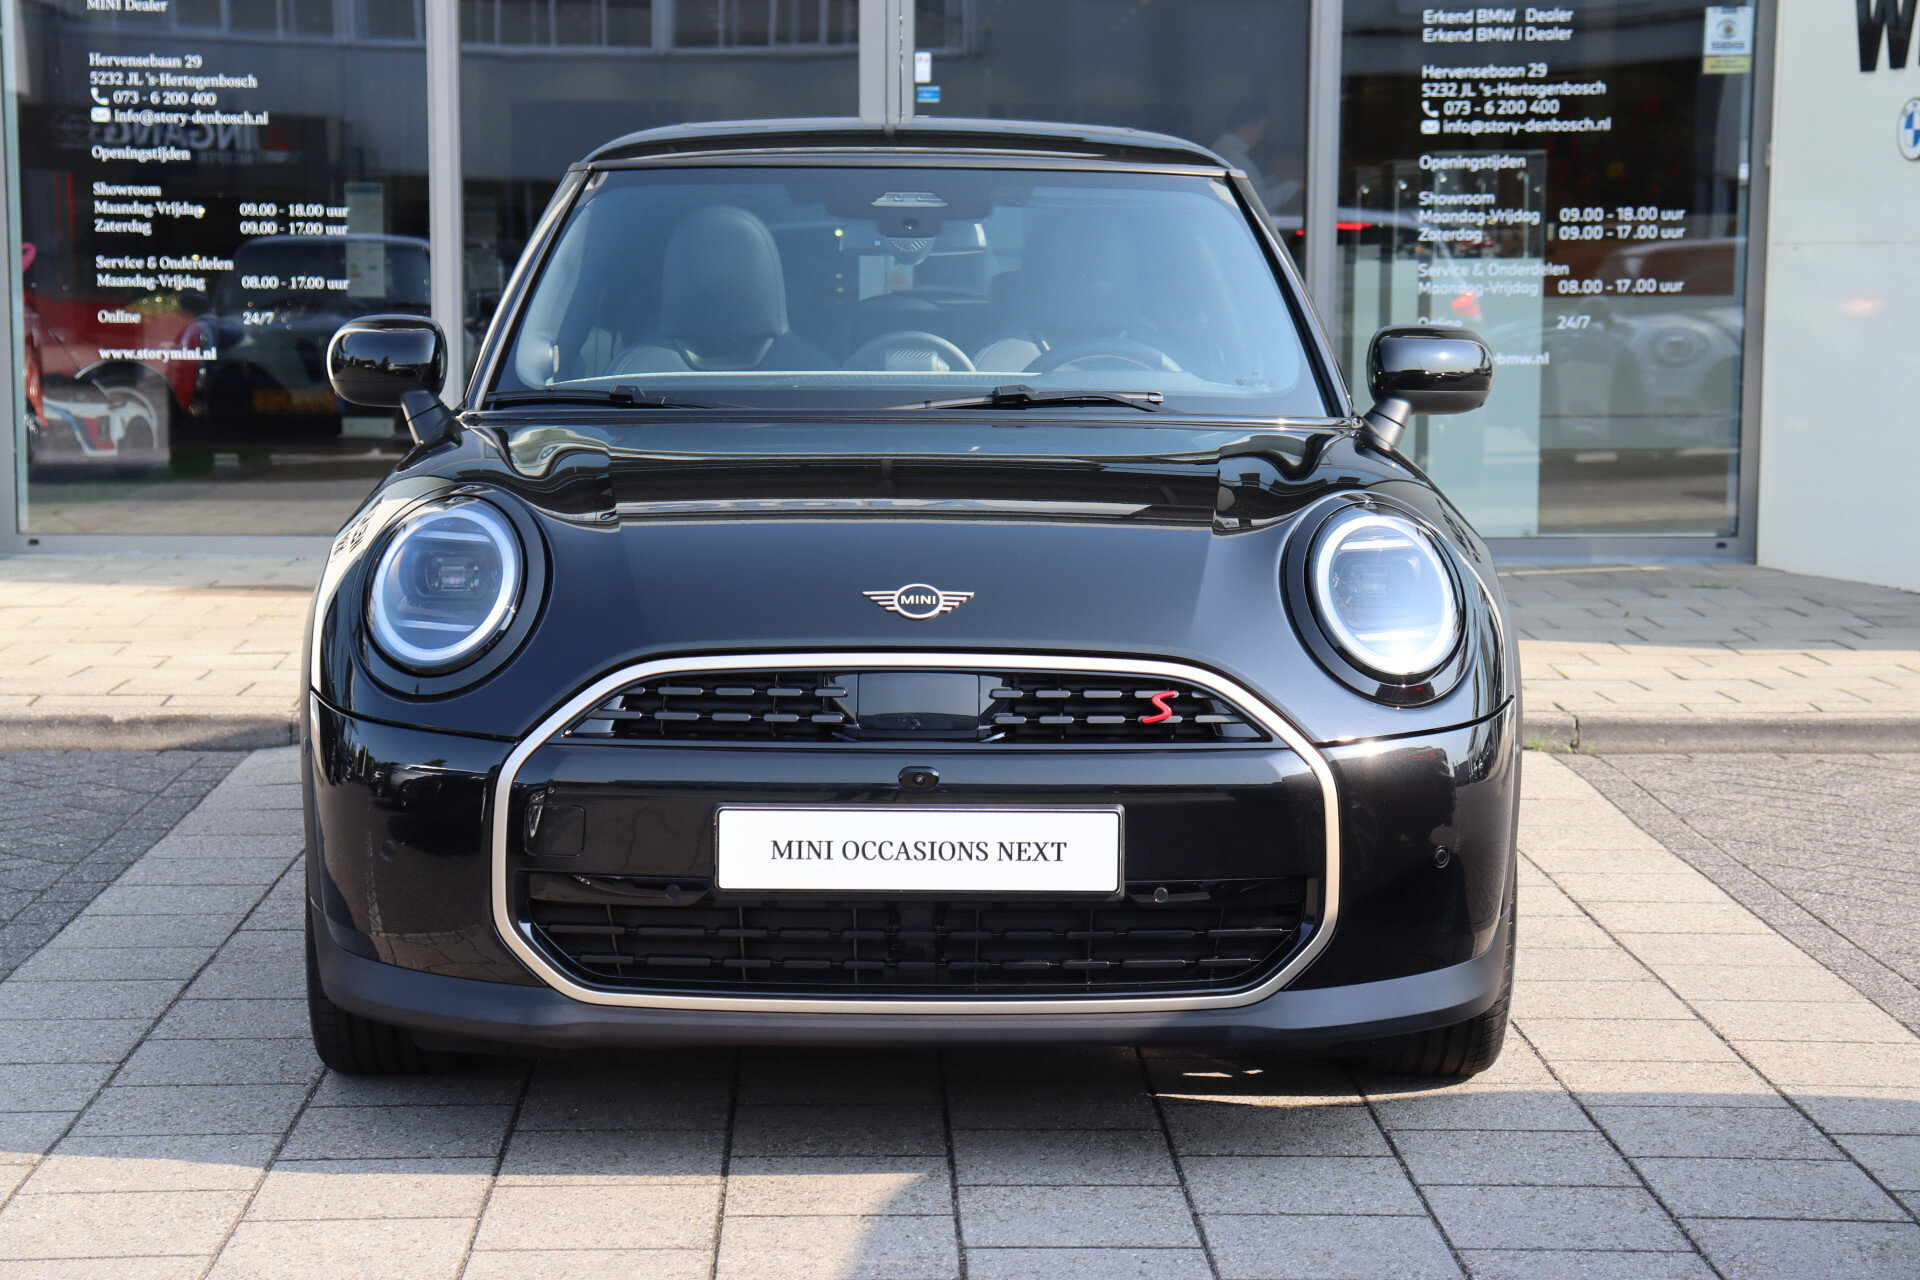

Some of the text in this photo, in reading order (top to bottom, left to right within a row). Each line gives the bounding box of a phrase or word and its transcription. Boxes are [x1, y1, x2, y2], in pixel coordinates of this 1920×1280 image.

[86, 0, 168, 12] MINI Dealer
[1422, 8, 1574, 24] Erkend BMW Dealer
[1422, 26, 1574, 42] Erkend BMW i Dealer
[88, 52, 202, 68] Hervensebaan 29
[90, 70, 124, 86] 5232
[126, 72, 144, 86] JL
[1422, 63, 1548, 79] Hervensebaan 29
[113, 90, 140, 104] 073
[150, 91, 160, 105] 6
[162, 92, 188, 105] 200
[190, 92, 218, 106] 400
[1421, 82, 1458, 98] 5232
[1460, 82, 1476, 98] JL
[1443, 100, 1472, 115] 073
[1484, 100, 1494, 114] 6
[1497, 100, 1527, 114] 200
[1529, 99, 1560, 114] 400
[114, 108, 269, 126] info@story-denbosch.nl
[1442, 116, 1612, 136] info@story-denbosch.nl
[92, 145, 191, 163] Openingstijden
[1419, 154, 1526, 172] Openingstijden
[92, 182, 162, 196] Showroom
[1418, 191, 1495, 206] Showroom
[94, 200, 204, 219] Maandag-Vrijdag
[239, 202, 278, 217] 09.00
[288, 203, 324, 218] 18.00
[326, 206, 350, 218] uur
[1418, 209, 1540, 225] Maandag-Vrijdag
[1559, 208, 1604, 222] 09.00
[1616, 206, 1658, 222] 18.00
[1660, 208, 1686, 220] uur
[94, 218, 152, 236] Zaterdag
[240, 220, 278, 235] 09.00
[288, 222, 324, 236] 17.00
[326, 224, 350, 236] uur
[1418, 228, 1482, 244] Zaterdag
[1559, 225, 1604, 240] 09.00
[1660, 227, 1686, 239] uur
[96, 254, 234, 270] Service & Onderdelen
[1418, 262, 1570, 278] Service & Onderdelen
[96, 273, 206, 292] Maandag-Vrijdag
[241, 275, 279, 290] 08.00
[290, 276, 325, 290] 17.00
[326, 279, 350, 290] uur
[1418, 281, 1538, 297] Maandag-Vrijdag
[1558, 280, 1603, 294] 08.00
[1660, 280, 1685, 292] uur
[98, 310, 275, 325] Online 24/7
[1556, 315, 1591, 330] 24/7
[98, 347, 217, 363] www.storymini.nl
[900, 595, 936, 605] MINI
[1141, 690, 1176, 724] S
[770, 840, 1068, 862] MINI OCCASIONS NEXT
